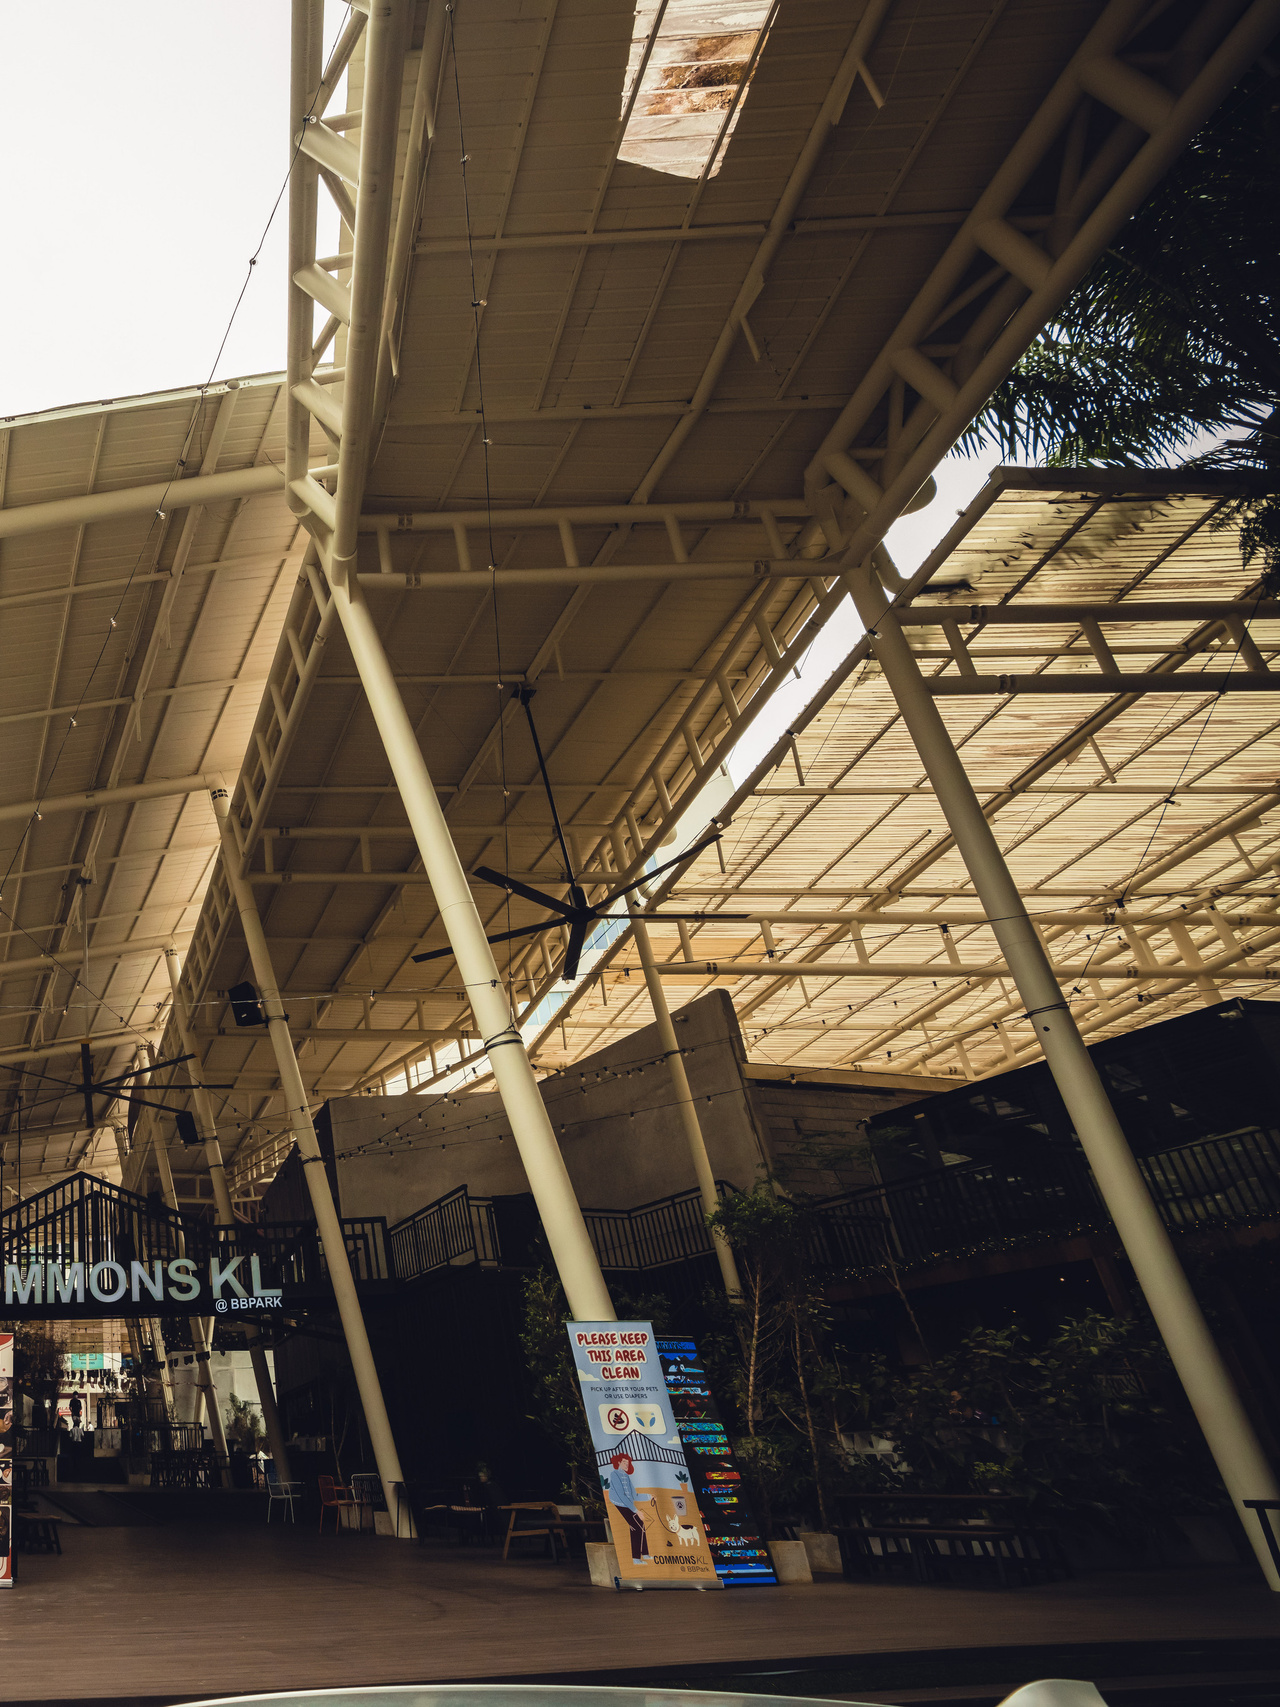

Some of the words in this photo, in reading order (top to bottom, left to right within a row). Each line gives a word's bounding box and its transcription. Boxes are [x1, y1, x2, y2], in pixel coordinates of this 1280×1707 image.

[210, 1255, 283, 1299] KL
[215, 1299, 228, 1313] @
[231, 1296, 283, 1310] BBPARK
[576, 1332, 619, 1346] PLEASE
[619, 1332, 648, 1346] KEEP
[587, 1349, 613, 1362] THIS
[615, 1349, 646, 1362] AREA
[601, 1366, 640, 1380] CLEAN
[686, 1565, 710, 1573] BBPark
